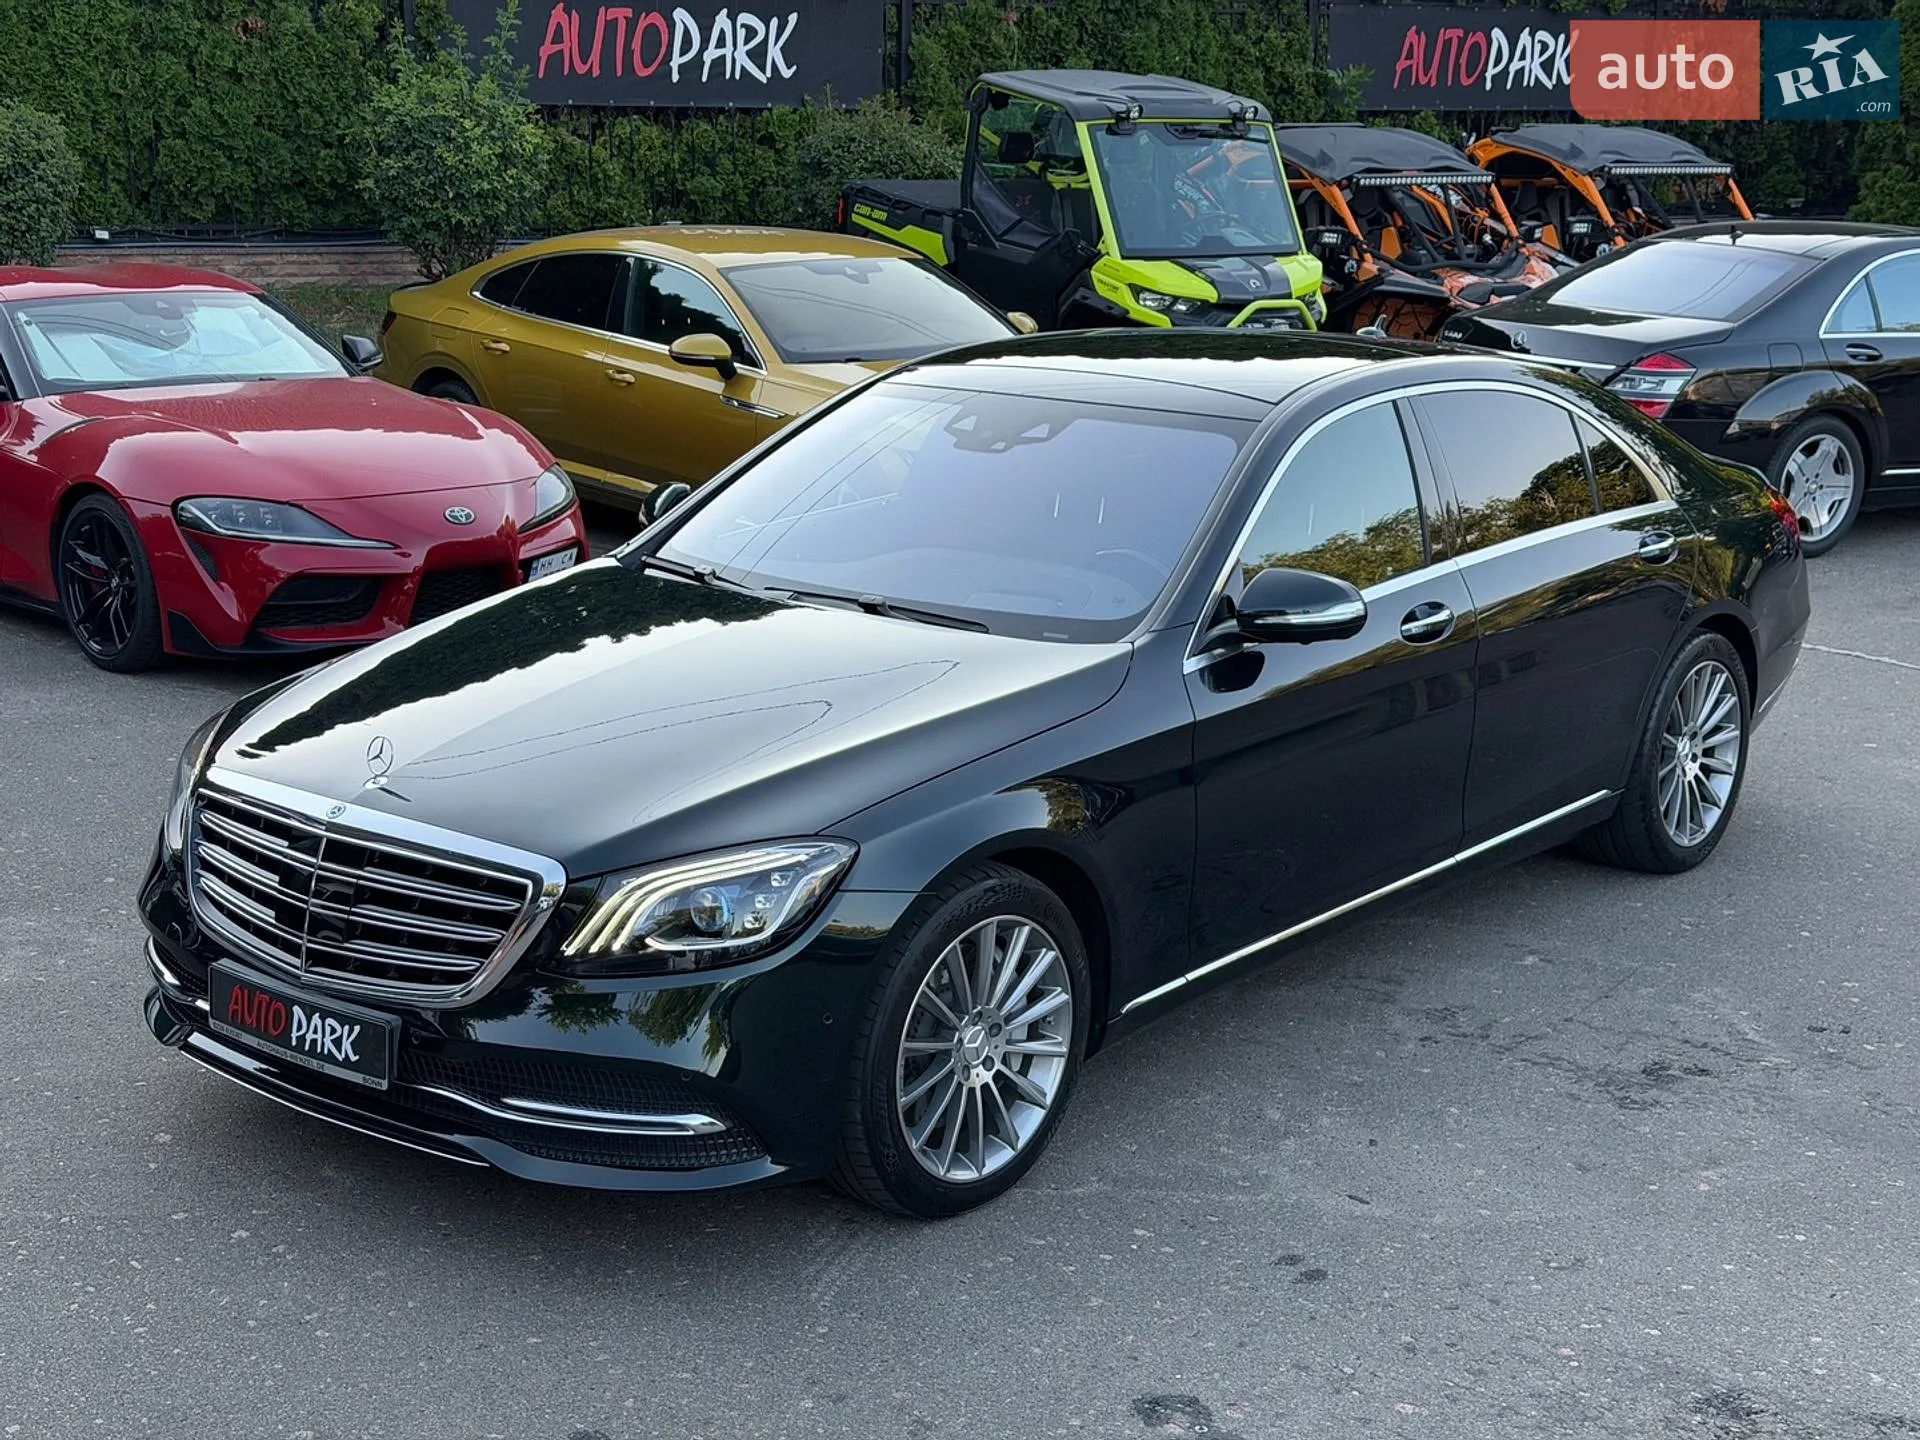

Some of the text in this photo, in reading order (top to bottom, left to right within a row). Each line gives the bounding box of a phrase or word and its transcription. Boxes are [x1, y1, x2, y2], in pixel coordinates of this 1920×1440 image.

[853, 202, 888, 221] can-am
[228, 984, 361, 1063] AUTO PARK
[362, 1076, 383, 1089] BONN
